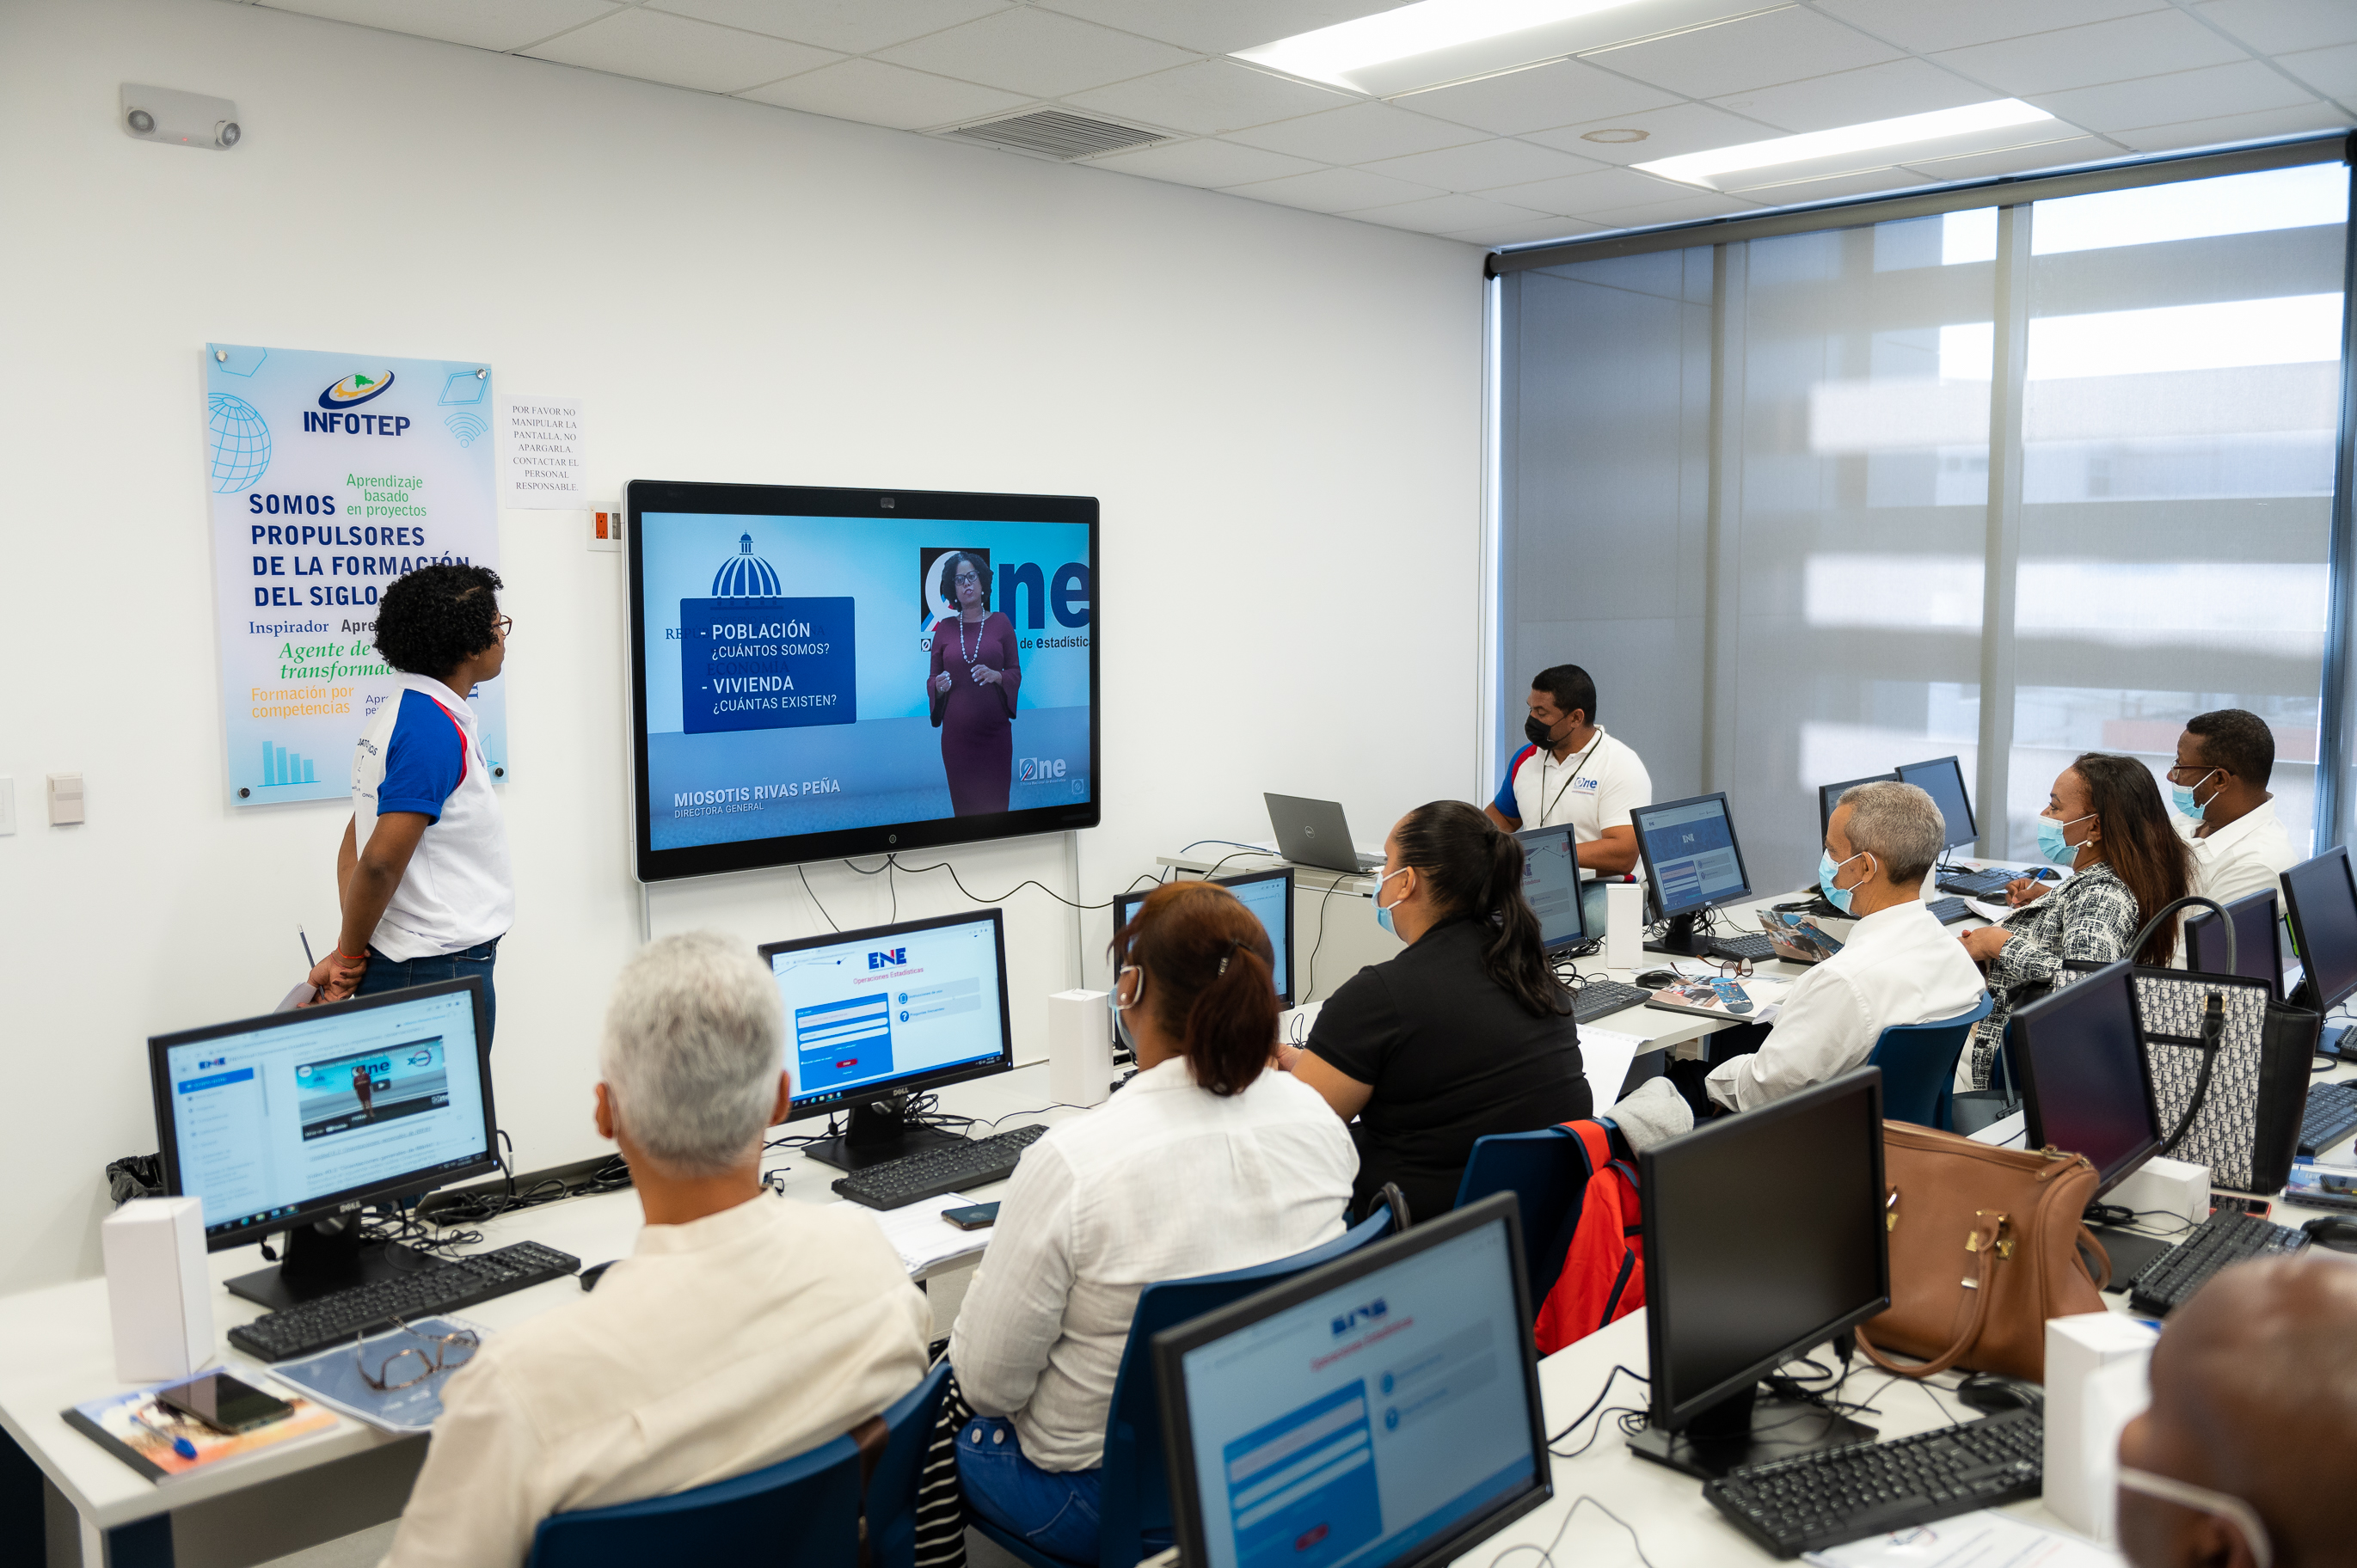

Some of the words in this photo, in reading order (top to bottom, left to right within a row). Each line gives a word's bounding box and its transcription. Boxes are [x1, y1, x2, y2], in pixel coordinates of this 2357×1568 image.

[513, 405, 530, 414] POR
[531, 407, 562, 416] FAVOR
[563, 408, 576, 417] NO
[303, 411, 411, 437] INFOTEP
[512, 418, 564, 428] MANIPULAR
[566, 420, 577, 429] LA
[513, 431, 562, 441] PANTALLA,
[513, 456, 567, 467] CONTACTAR
[346, 473, 423, 491] Aprendizaje
[525, 469, 569, 479] PERSONAL
[364, 488, 409, 503] basado
[516, 481, 579, 492] RESPONSABLE.
[249, 493, 336, 516] SOMOS
[347, 505, 362, 516] en
[366, 504, 427, 518] proyectos
[251, 524, 425, 547] PROPULSORES
[252, 555, 285, 576] DE
[294, 555, 324, 576] LA
[255, 586, 303, 607] DEL
[310, 585, 377, 606] SIGLO
[249, 620, 329, 638] Inspirador
[712, 619, 810, 640] POBLACIÓN
[278, 641, 345, 665] Agente
[350, 640, 371, 657] de
[711, 643, 777, 661] ¿CUÁNTOS
[781, 642, 830, 656] SOMOS?
[1020, 637, 1033, 650] de
[251, 684, 327, 701] Formación
[331, 686, 354, 701] por
[713, 675, 795, 694] VIVIENDA
[252, 701, 350, 720] competencias
[713, 696, 778, 715] ¿CUÁNTAS
[782, 694, 837, 709] EXISTEN?
[674, 787, 751, 808] MIOSOTIS
[754, 782, 799, 800] RIVAS
[802, 776, 841, 796] PEÑA
[674, 805, 723, 818] DIRECTORA
[725, 802, 764, 813] GENERAL
[868, 946, 907, 970] ENE
[853, 972, 889, 985] Operaciones
[890, 966, 924, 978] Estadísticas
